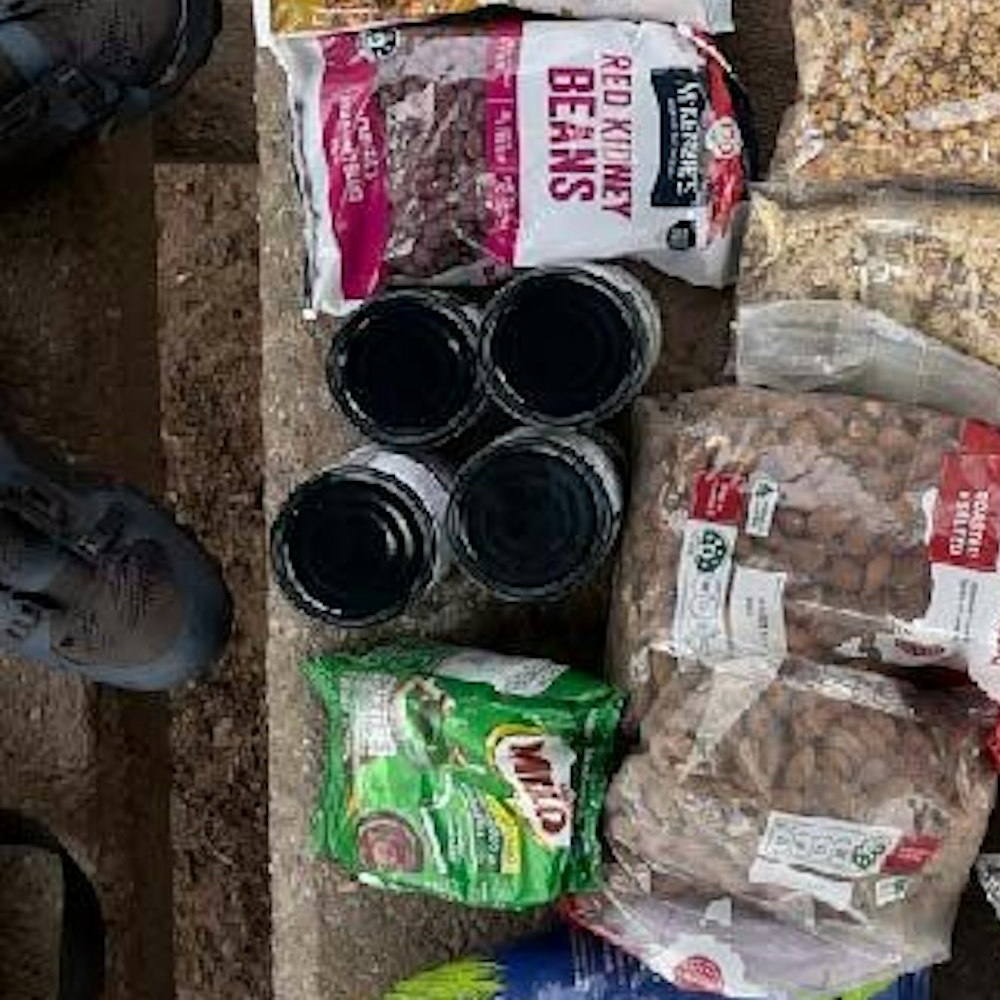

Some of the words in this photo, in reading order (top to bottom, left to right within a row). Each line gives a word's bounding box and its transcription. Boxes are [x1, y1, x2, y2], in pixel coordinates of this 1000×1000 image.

[601, 53, 632, 107] RED
[547, 66, 596, 204] BEANS
[601, 117, 632, 220] KIDNEY
[508, 737, 567, 834] MILO
